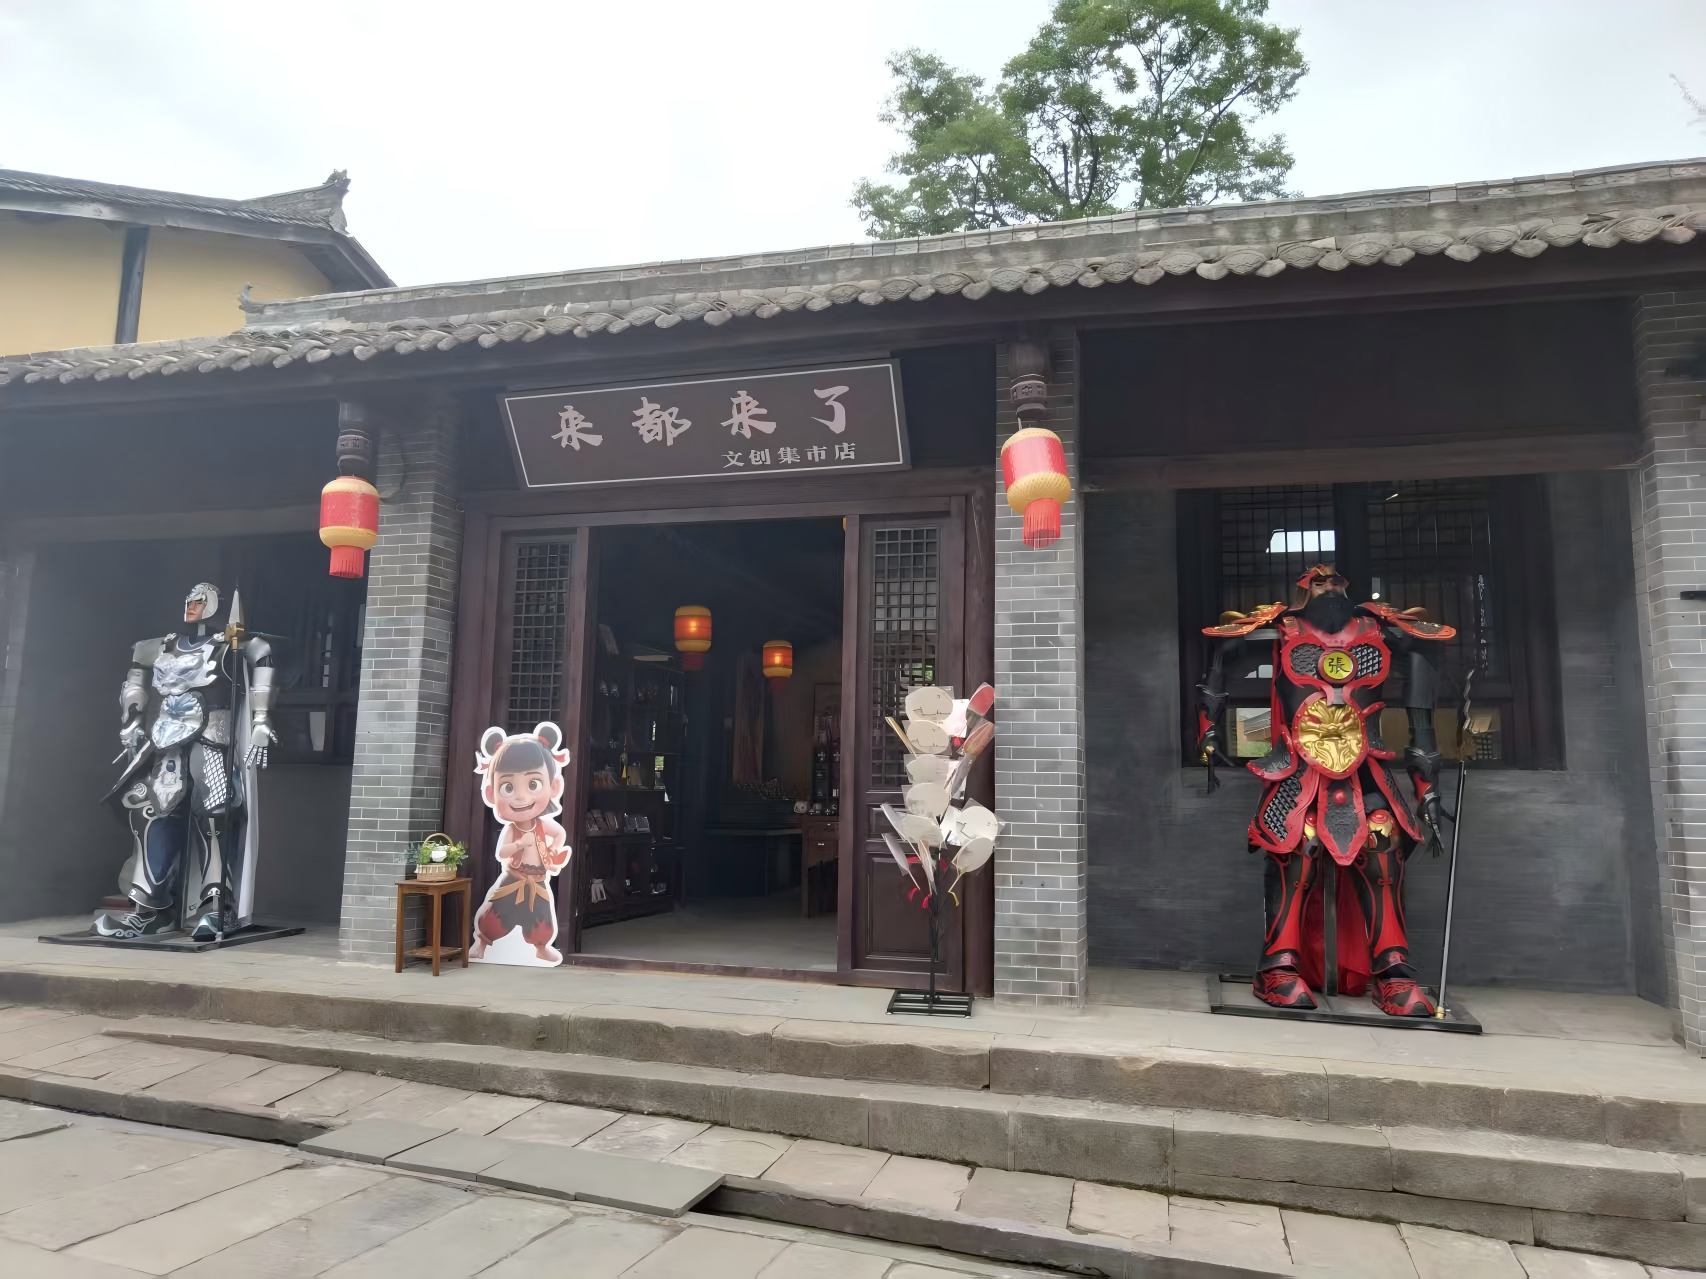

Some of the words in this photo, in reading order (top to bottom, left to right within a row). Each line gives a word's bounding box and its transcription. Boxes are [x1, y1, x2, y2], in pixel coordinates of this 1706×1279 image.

[551, 385, 850, 451] 来都来了
[721, 442, 857, 468] 文创集市店
